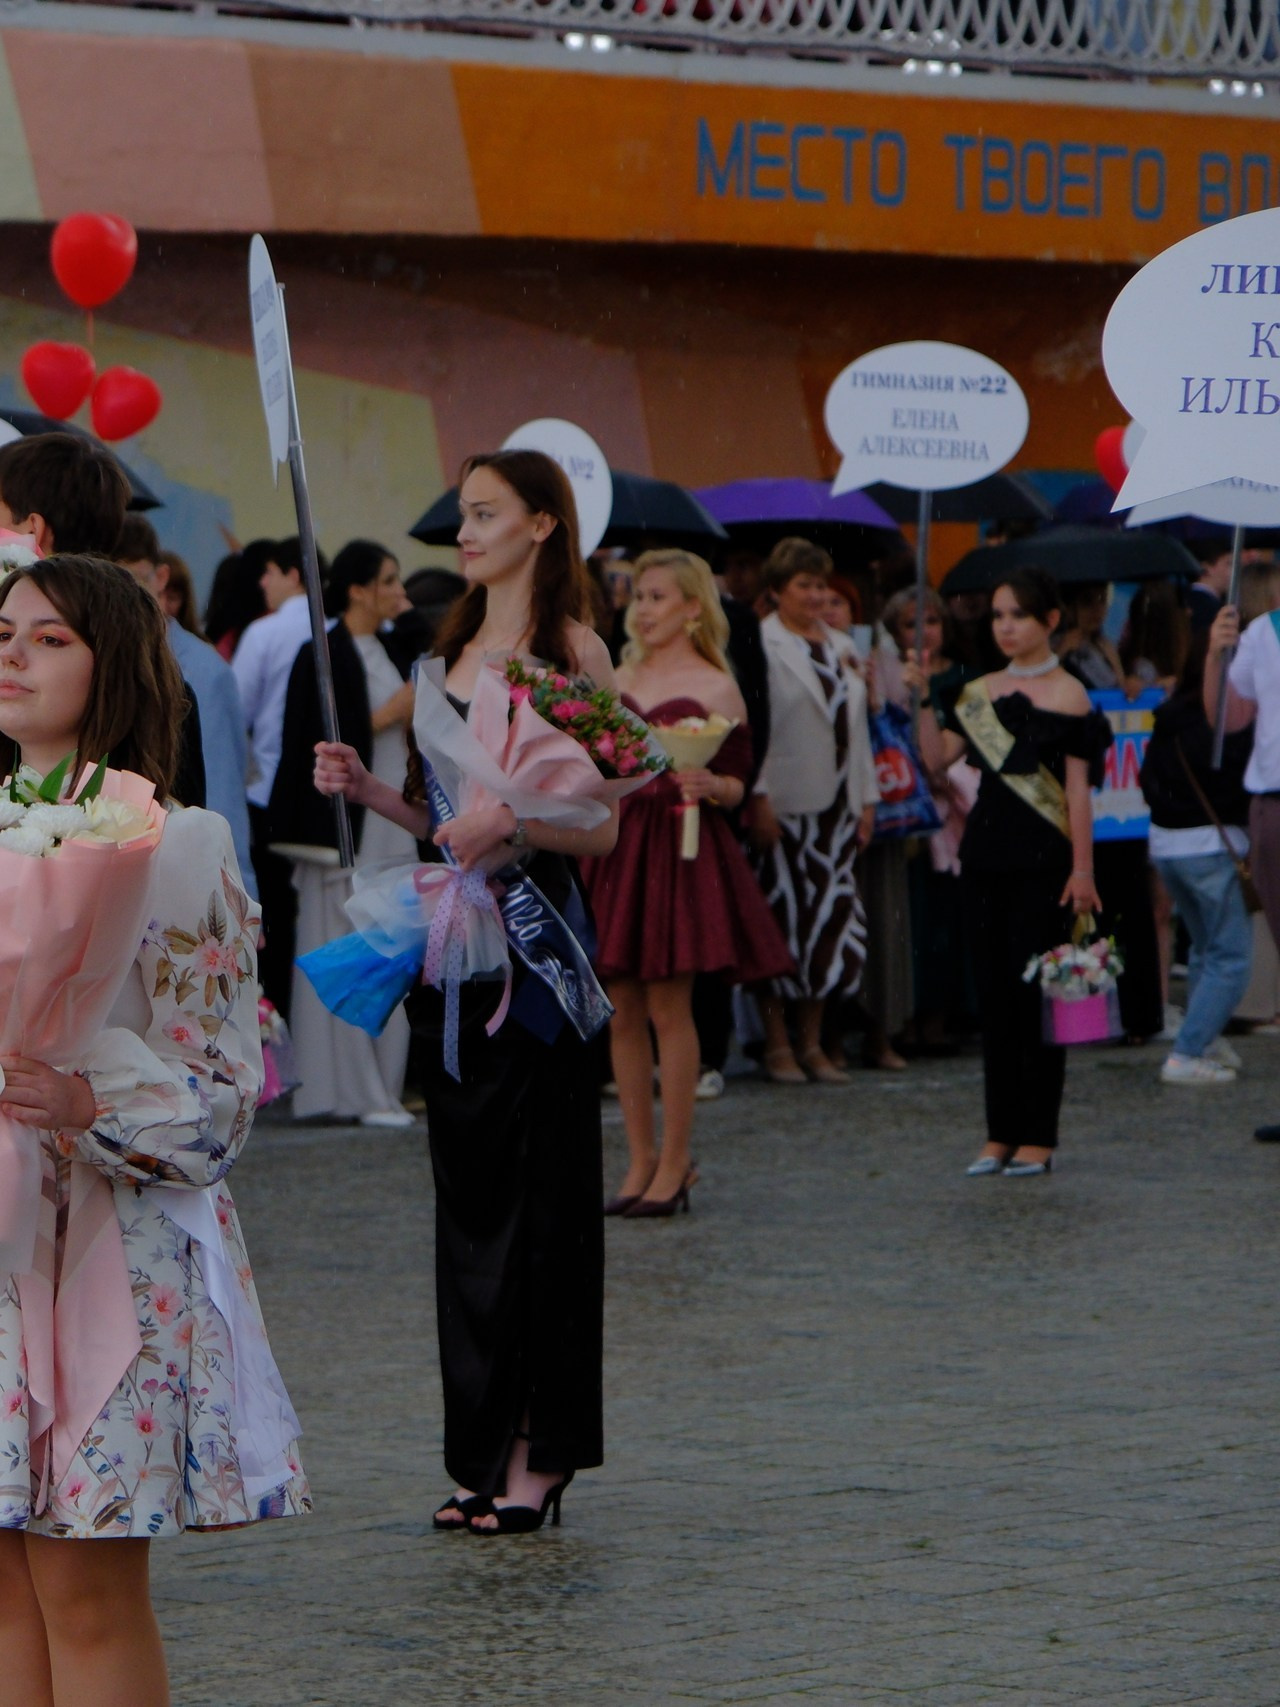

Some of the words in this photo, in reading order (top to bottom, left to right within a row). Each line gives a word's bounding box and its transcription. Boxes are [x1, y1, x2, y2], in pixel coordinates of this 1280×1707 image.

[696, 117, 907, 208] МЕСТО
[944, 134, 1166, 222] ТВОЕГО
[1201, 264, 1280, 294] ЛИ
[851, 371, 954, 393] ГИМНАЗИЯ
[959, 375, 1008, 395] №22
[891, 407, 959, 432] ЕЛЕНА
[858, 434, 990, 462] АЛЕКСЕЕВНА
